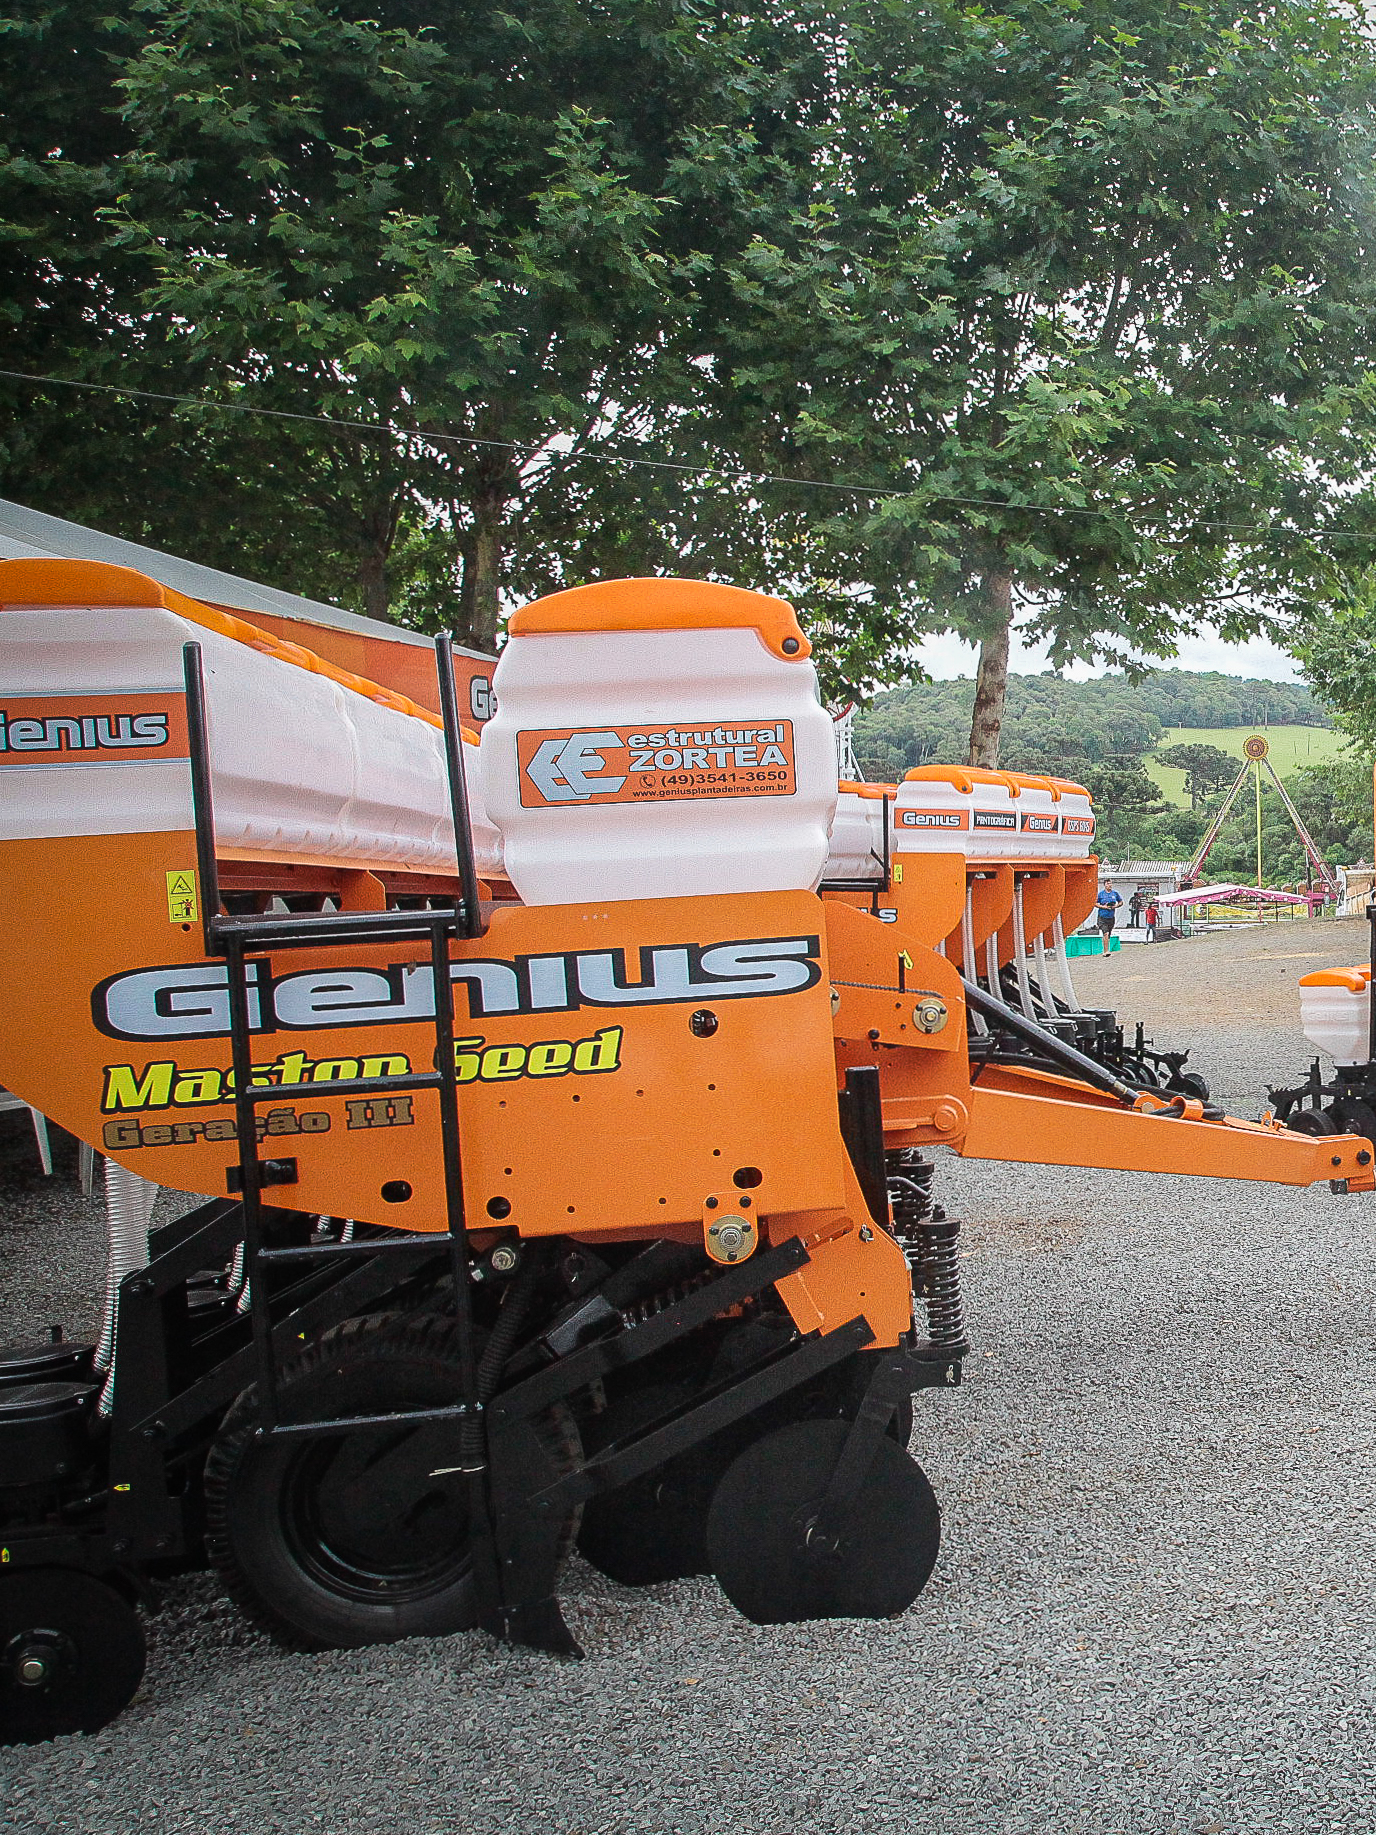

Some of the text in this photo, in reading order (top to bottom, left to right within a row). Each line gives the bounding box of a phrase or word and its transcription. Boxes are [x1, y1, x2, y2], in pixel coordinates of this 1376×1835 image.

[0, 700, 170, 753] enius
[627, 724, 784, 748] estrutural
[628, 744, 789, 772] ZORTEA
[632, 783, 788, 798] www.geniusplantadeiras.com.br
[661, 771, 788, 787] (49)3541-3650
[902, 811, 961, 827] Genius
[1028, 816, 1053, 830] Genius
[91, 934, 821, 1042] Genius
[440, 1025, 624, 1085] Seed
[345, 1096, 415, 1130] III
